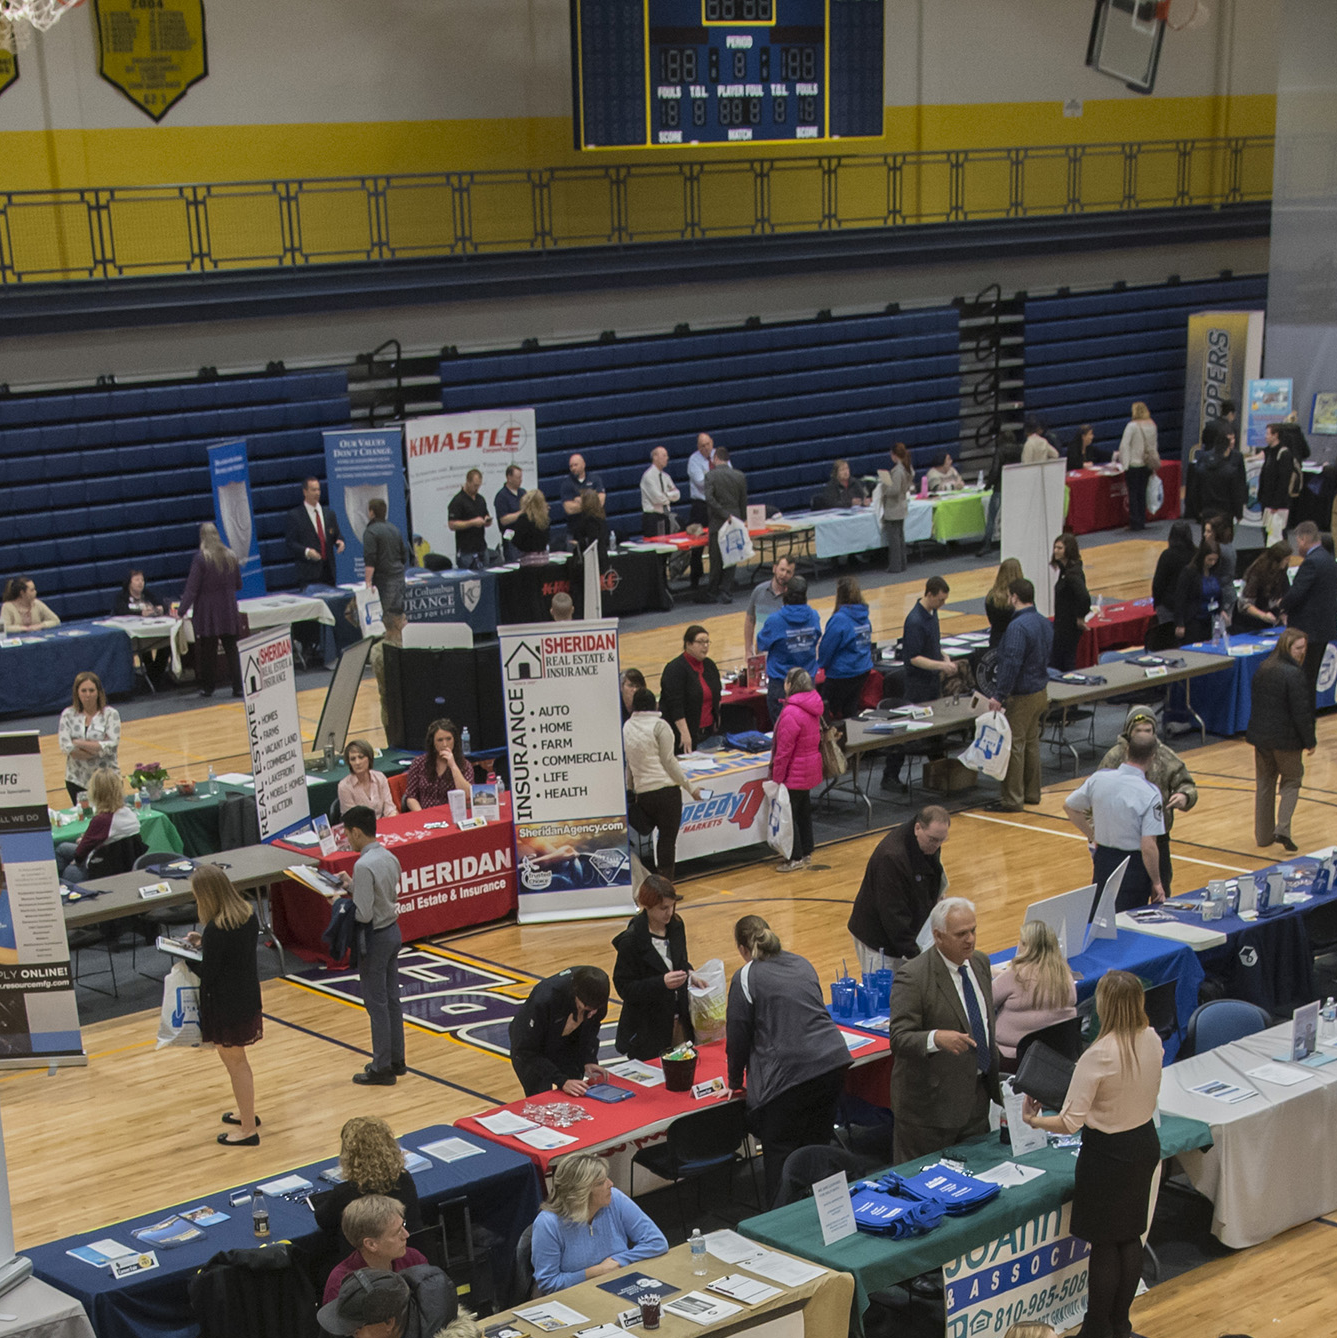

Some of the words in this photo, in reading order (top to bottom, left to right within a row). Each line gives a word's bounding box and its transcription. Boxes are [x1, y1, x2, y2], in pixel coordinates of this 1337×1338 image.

[409, 427, 521, 458] KIMASTLE
[414, 584, 454, 598] Columbus
[440, 608, 456, 617] LIFE
[260, 639, 292, 665] SHERIDAN
[545, 634, 616, 654] SHERIDAN
[546, 655, 570, 666] REAL
[573, 653, 605, 664] ESTATE
[607, 653, 615, 662] &
[547, 665, 598, 678] INSURANCE
[262, 710, 278, 725] HOMES
[539, 705, 570, 717] AUTO
[263, 726, 279, 739] FARMS
[540, 722, 572, 734] HOME
[247, 702, 262, 775] ESTATE
[265, 739, 284, 755] VACANT
[284, 733, 298, 747] LAND
[541, 738, 572, 750] FARM
[266, 751, 297, 770] COMMERCIAL
[508, 688, 533, 820] INSURANCE
[542, 752, 617, 766] COMMERCIAL
[268, 765, 295, 785] LAKEFRONT
[543, 771, 568, 783] LIFE
[270, 782, 287, 799] MOBILE
[287, 775, 305, 792] HOMES
[545, 787, 588, 799] HEALTH
[258, 787, 269, 836] REAL
[271, 797, 293, 814] AUCTION
[12, 815, 24, 823] WE
[26, 814, 39, 822] DO
[684, 819, 723, 834] MARKETS
[519, 822, 623, 838] SheridanAgency.com
[395, 847, 512, 895] HERIDAN
[394, 899, 414, 914] Real
[417, 893, 448, 909] Estate
[450, 889, 457, 901] &
[460, 879, 506, 899] Insurance
[21, 967, 68, 979] ONLINE!
[947, 1288, 955, 1310] &
[994, 1269, 1088, 1333] 810-985-508
